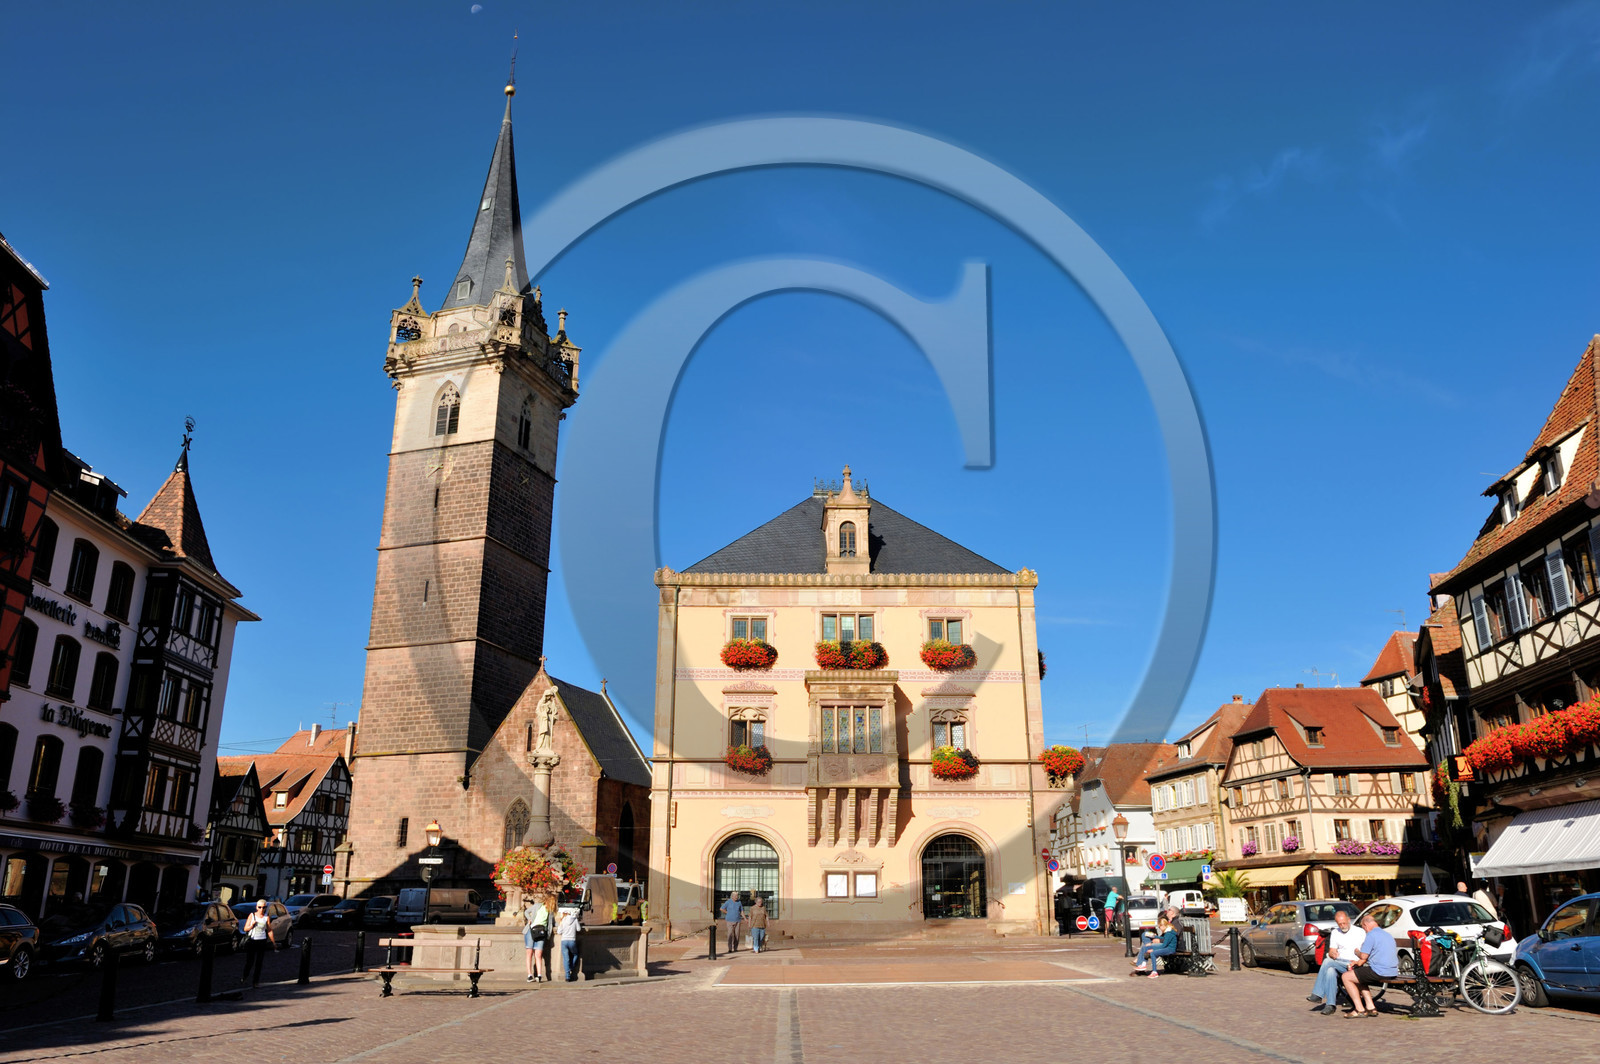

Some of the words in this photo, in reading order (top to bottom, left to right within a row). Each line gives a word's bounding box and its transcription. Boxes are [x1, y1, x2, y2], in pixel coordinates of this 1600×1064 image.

[27, 594, 77, 626] ostellerie
[59, 705, 112, 738] Diligence
[68, 844, 79, 853] DE
[81, 846, 91, 855] LA
